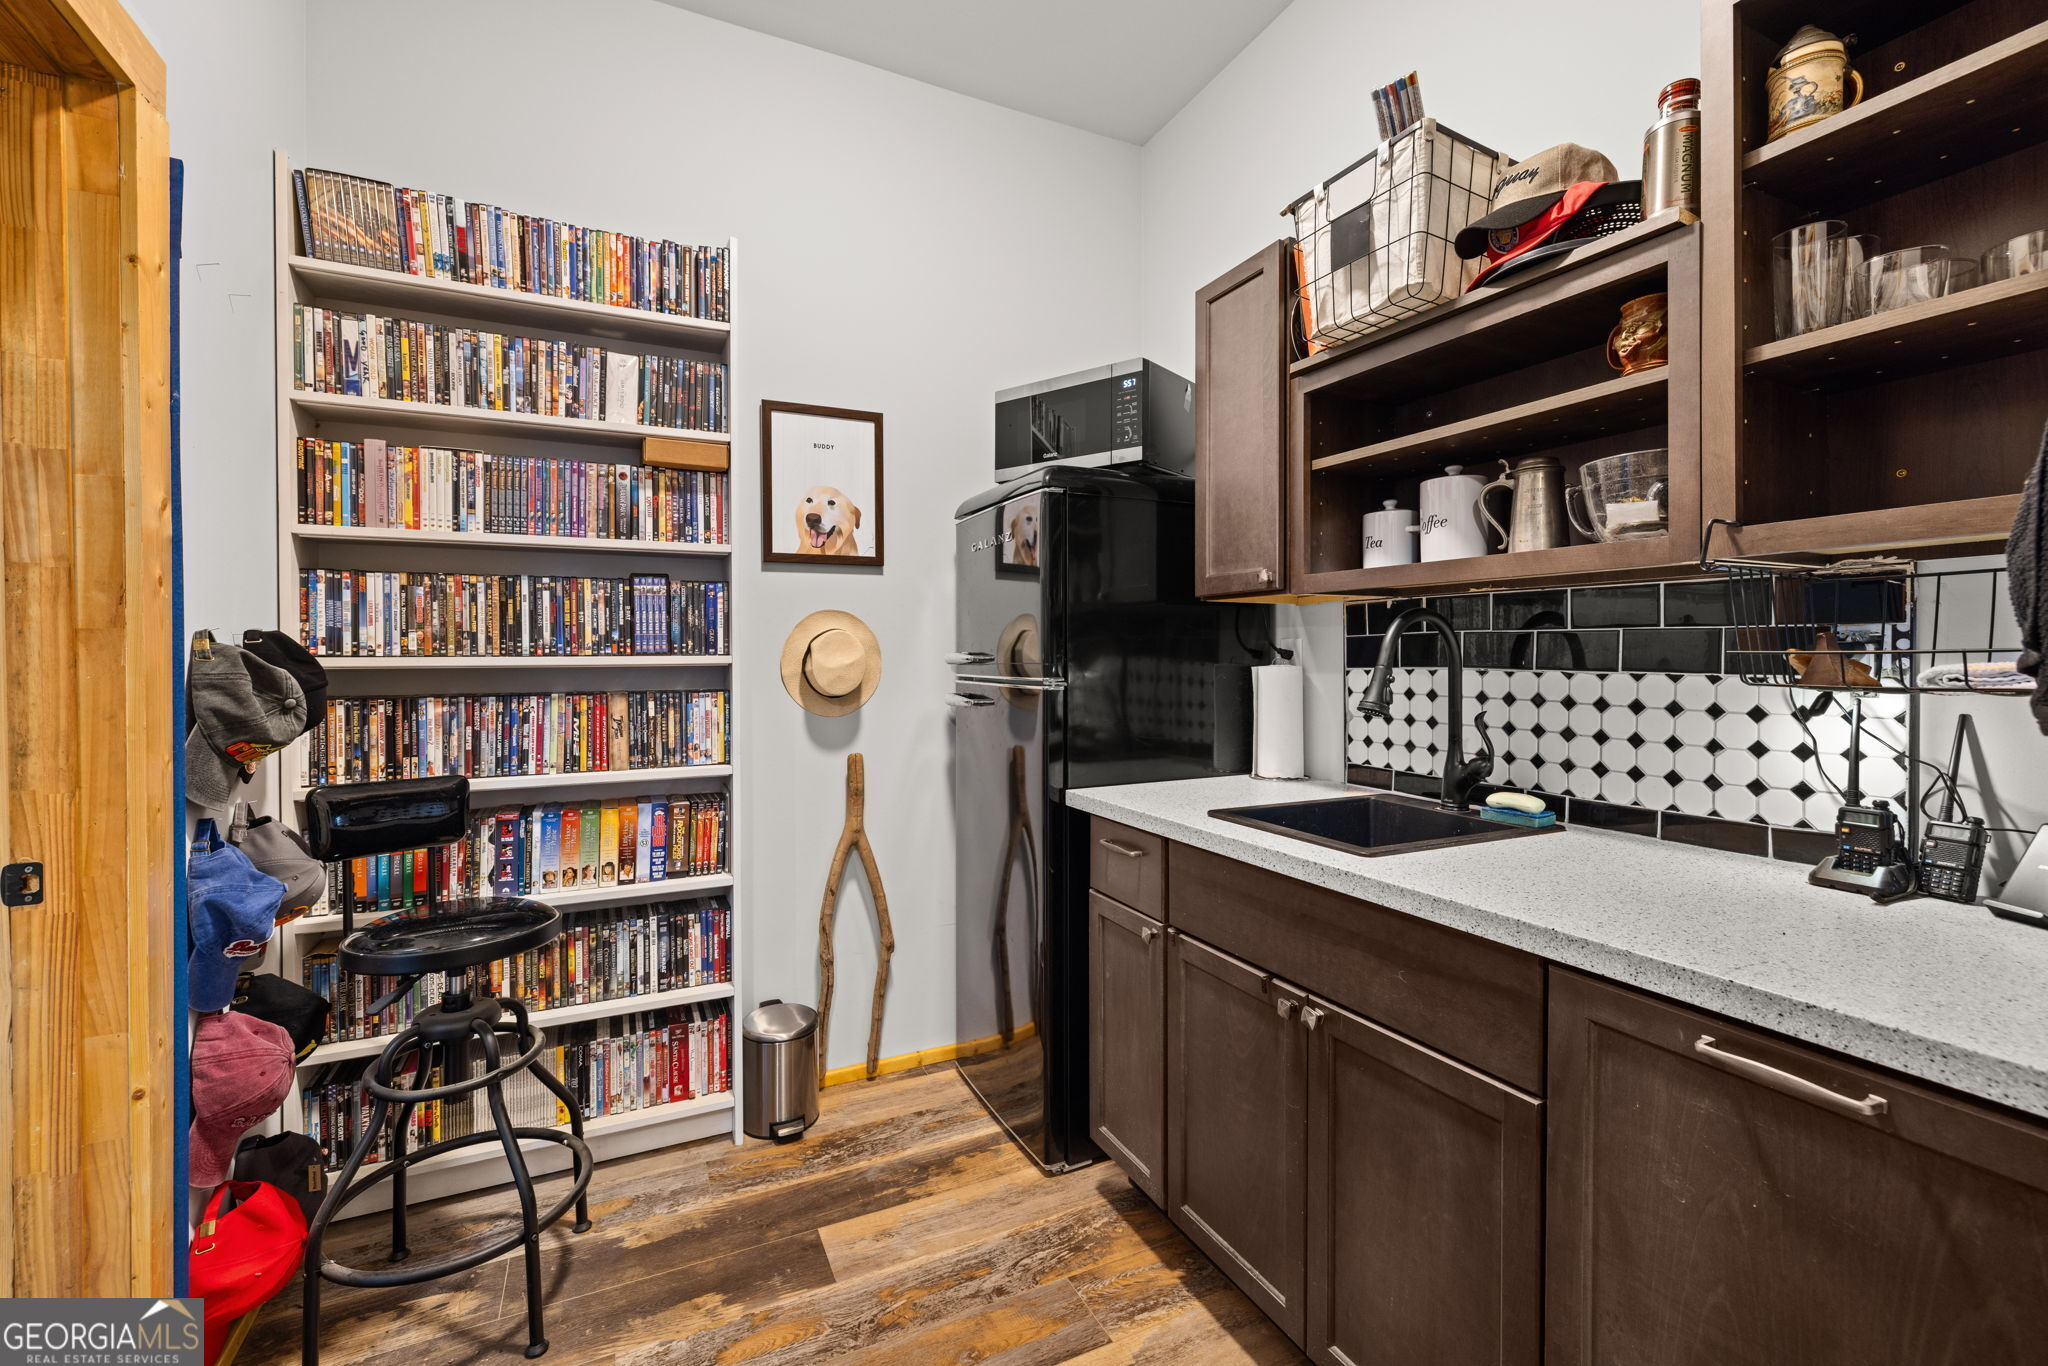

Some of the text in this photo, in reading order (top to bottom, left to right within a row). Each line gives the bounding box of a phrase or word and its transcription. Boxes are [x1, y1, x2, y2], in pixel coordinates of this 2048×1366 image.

[1680, 134, 1693, 194] MAGNUM
[1421, 514, 1448, 535] offee
[972, 531, 1012, 552] GALANZ
[1365, 536, 1383, 550] Tea
